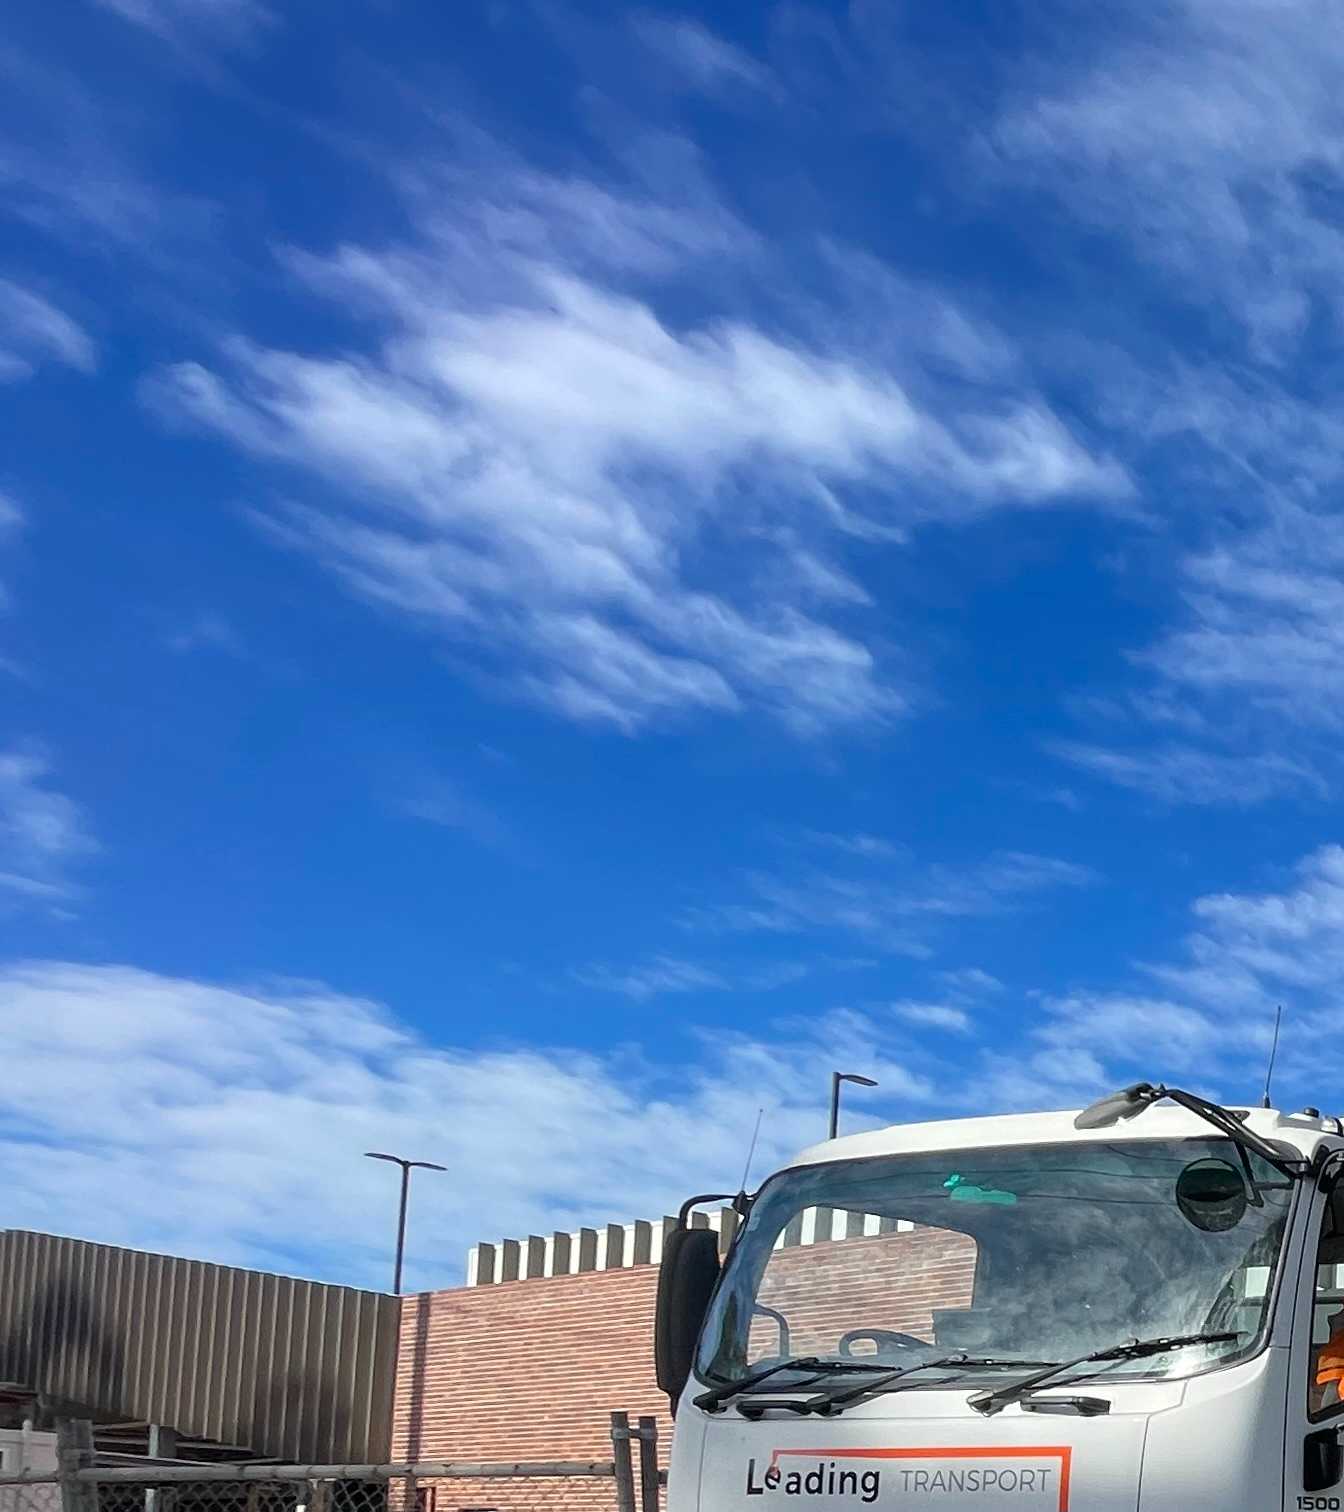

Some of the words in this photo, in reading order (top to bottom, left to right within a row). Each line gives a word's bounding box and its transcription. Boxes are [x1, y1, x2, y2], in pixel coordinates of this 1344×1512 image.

[746, 1458, 881, 1503] Leading
[900, 1468, 1052, 1492] TRANSPORT
[1296, 1496, 1340, 1511] 1500
